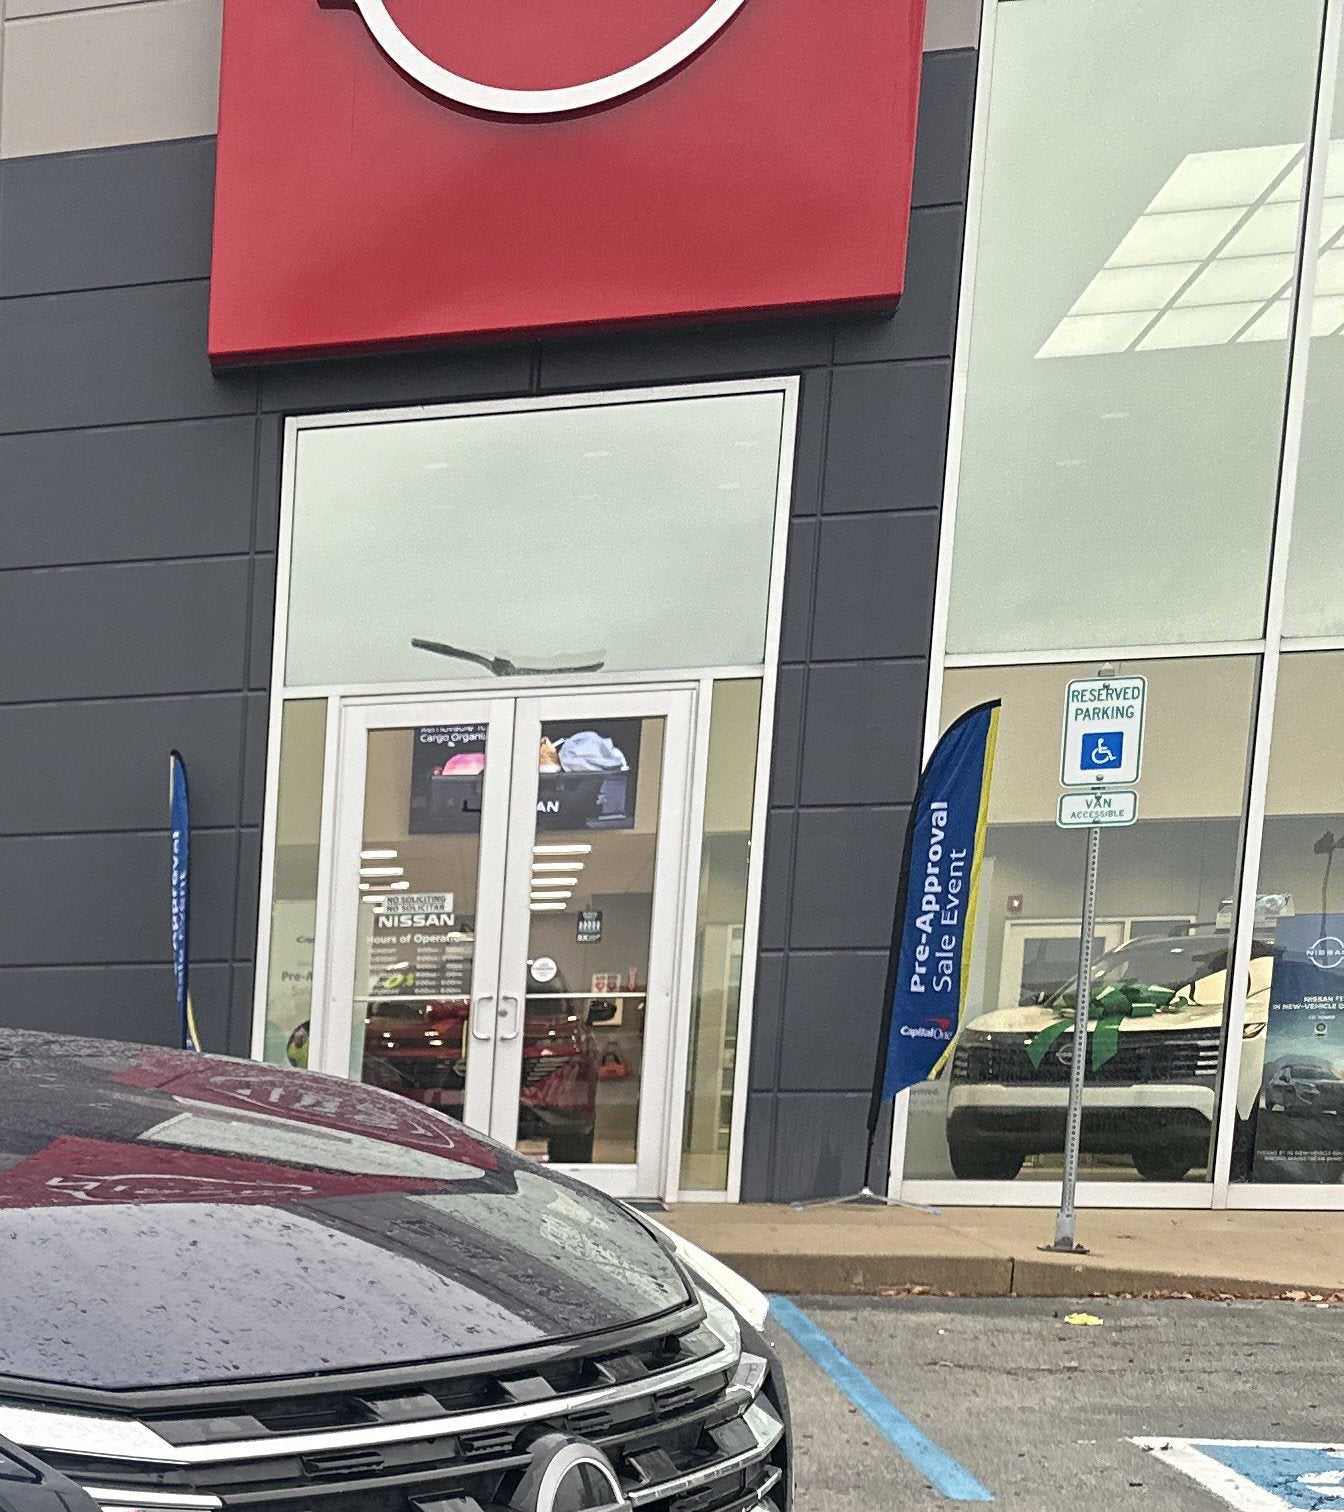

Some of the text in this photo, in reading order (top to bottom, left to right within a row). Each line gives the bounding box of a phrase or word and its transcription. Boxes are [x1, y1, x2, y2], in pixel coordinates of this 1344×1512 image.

[1072, 686, 1141, 703] RESERVED
[1074, 705, 1135, 721] PARKING
[420, 733, 449, 744] Cargo
[1085, 798, 1113, 809] VAN
[1070, 809, 1125, 819] ACCESSIBLE
[401, 895, 446, 904] SOLICITING
[910, 801, 949, 993] Pre-Approval
[378, 914, 455, 928] NISSAN
[933, 848, 967, 993] Sale Event
[399, 934, 411, 944] of
